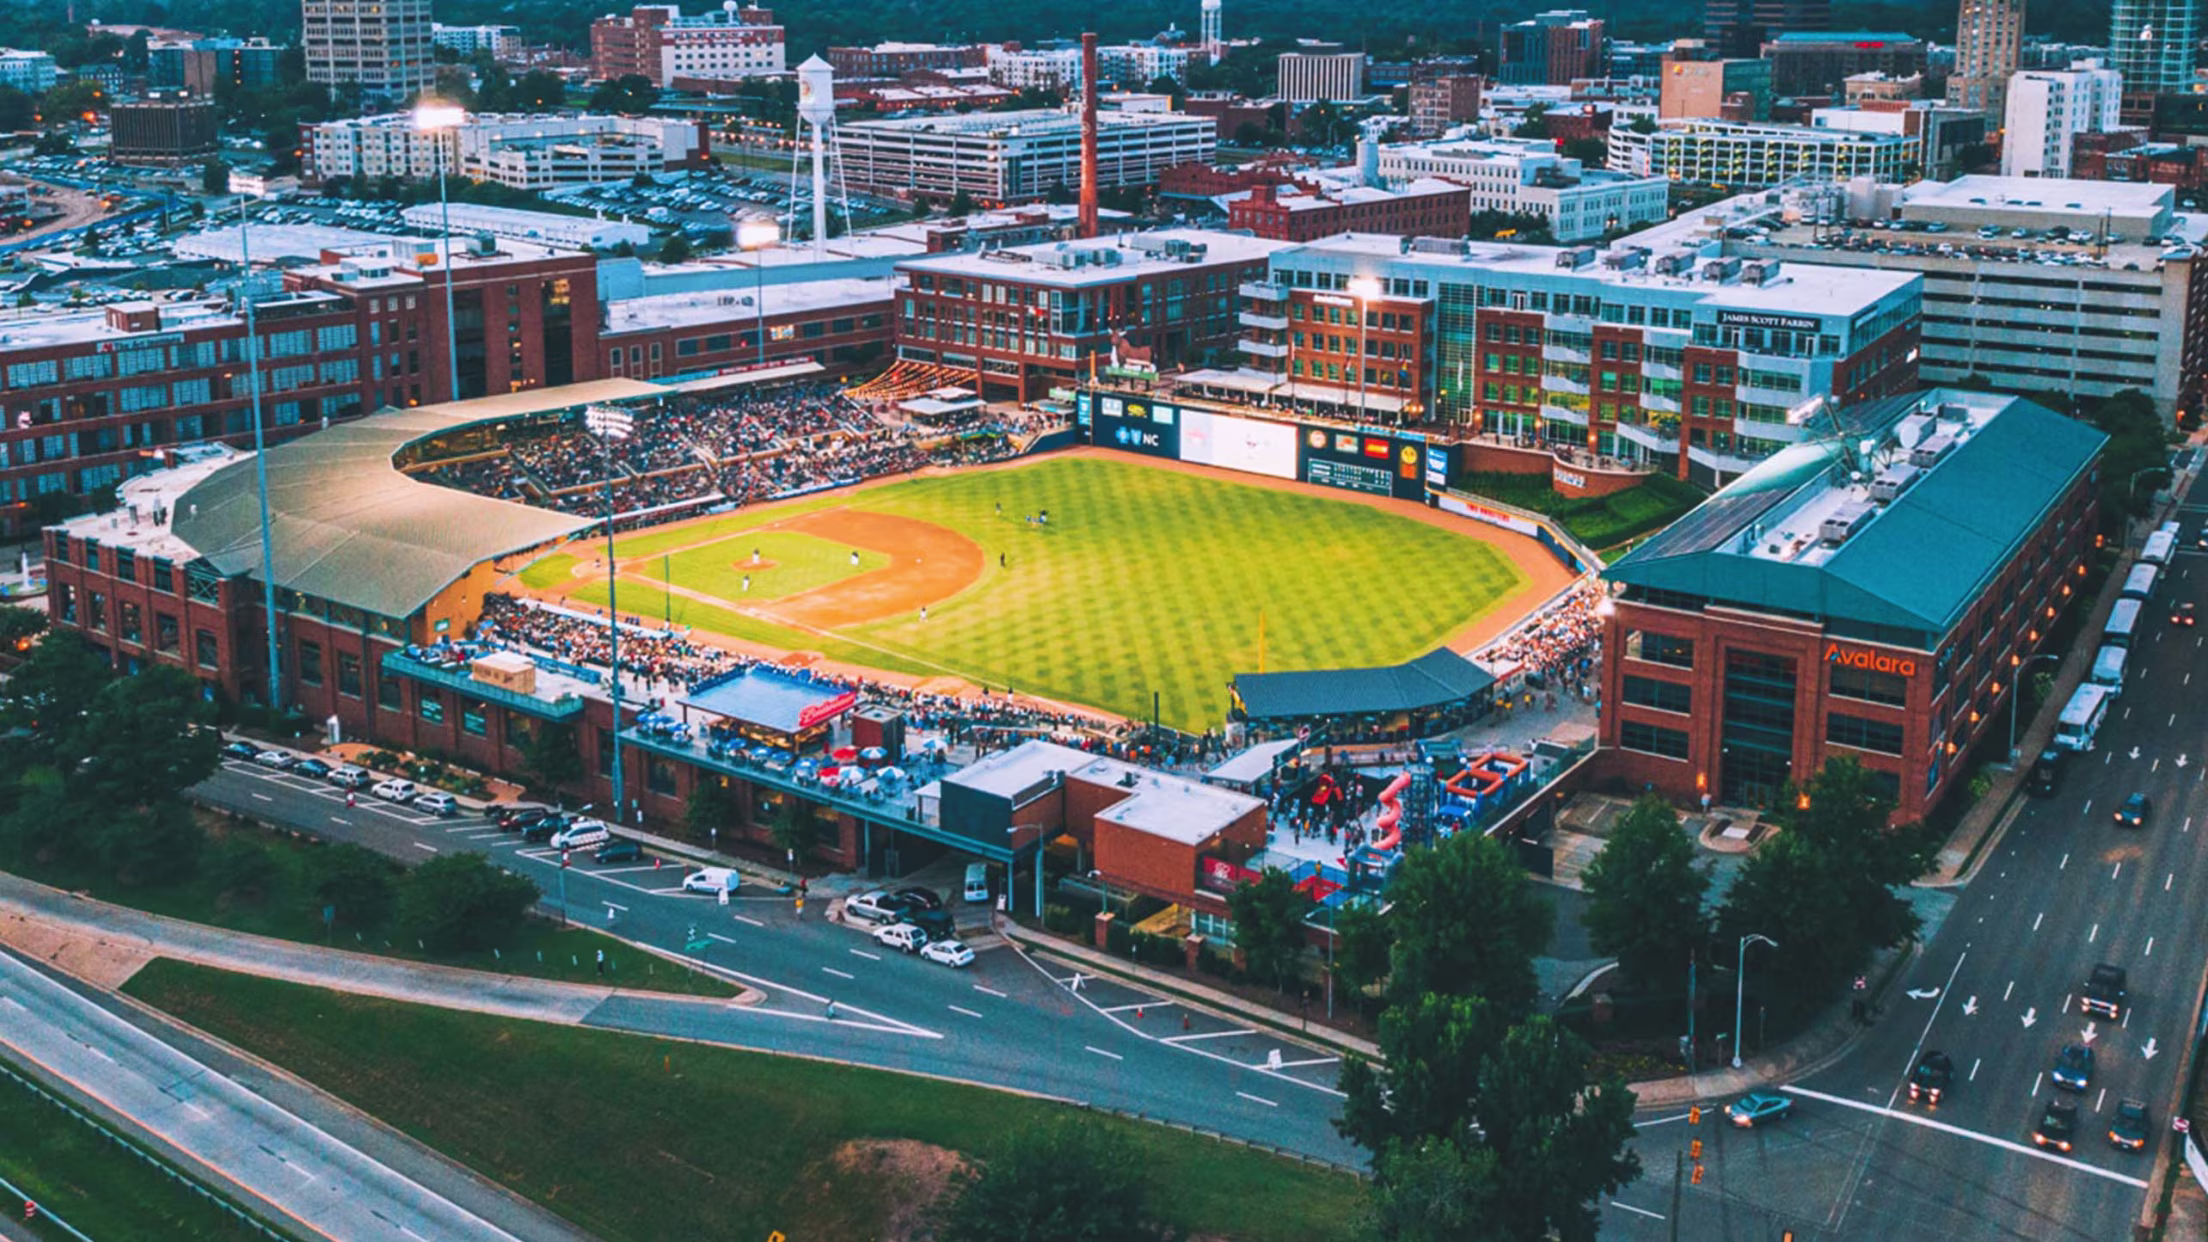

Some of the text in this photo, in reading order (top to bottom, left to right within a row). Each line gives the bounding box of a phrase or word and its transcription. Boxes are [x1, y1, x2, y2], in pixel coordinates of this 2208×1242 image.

[1722, 312, 1816, 328] JAMES SCOTT FARRIN
[1143, 433, 1159, 447] NC
[1824, 643, 1916, 677] Avalara
